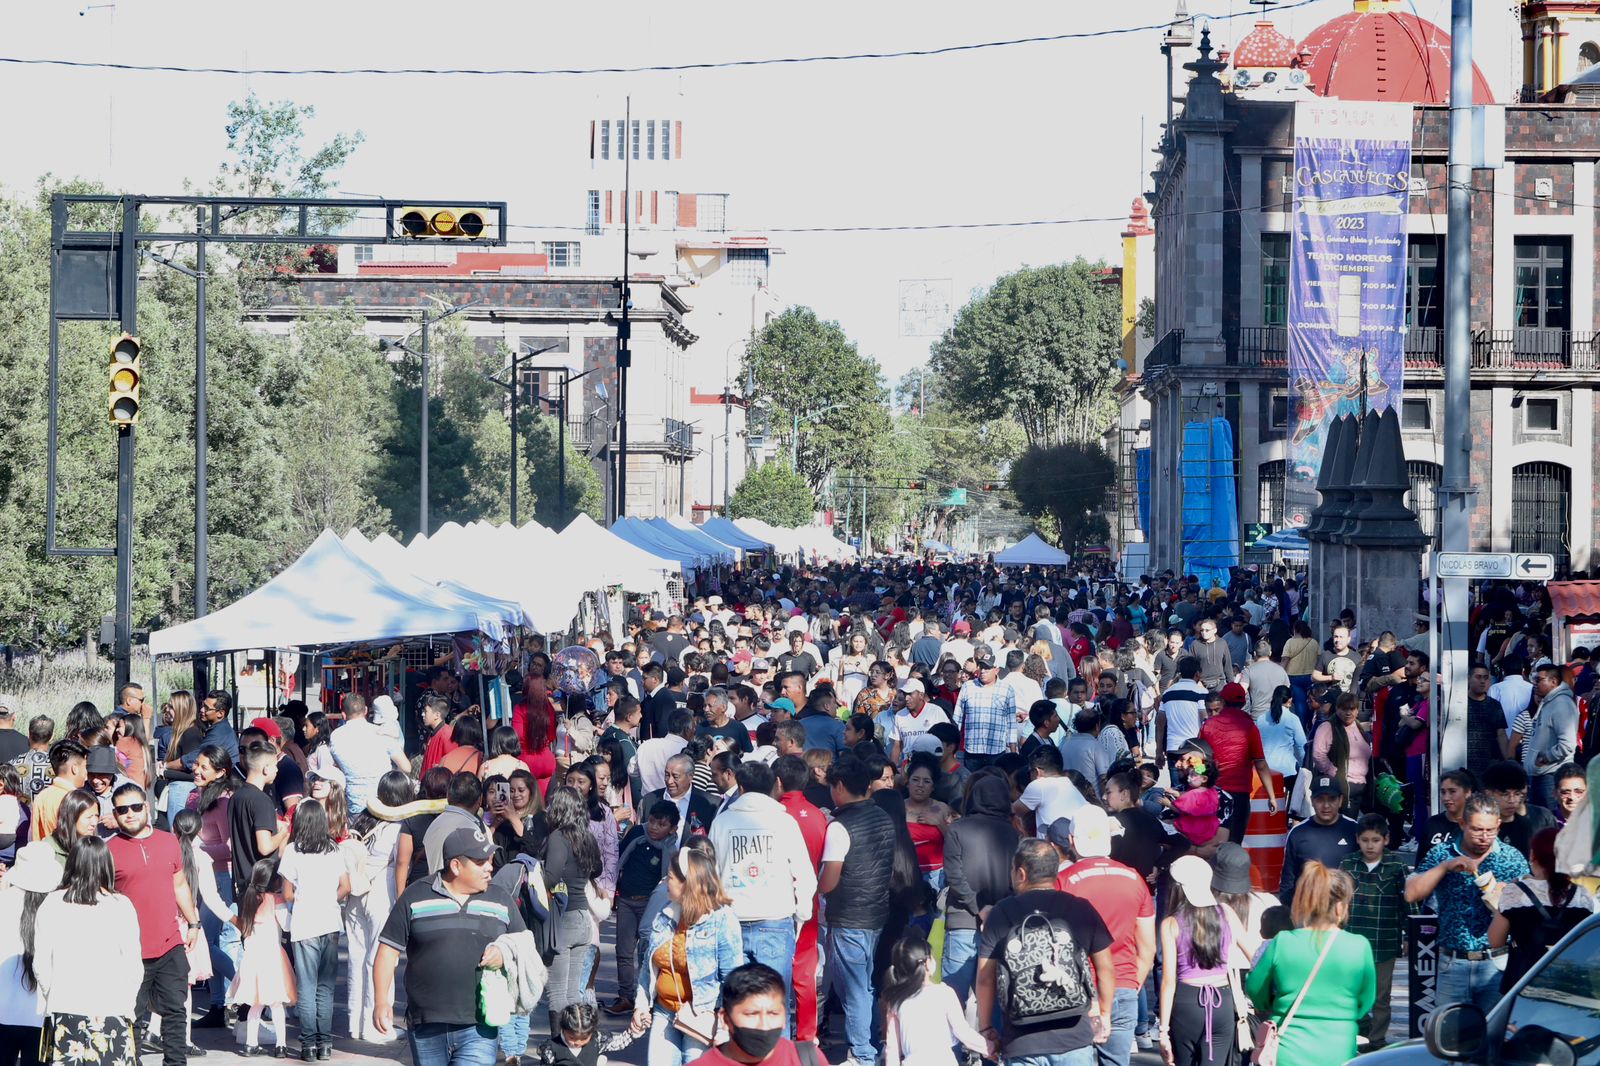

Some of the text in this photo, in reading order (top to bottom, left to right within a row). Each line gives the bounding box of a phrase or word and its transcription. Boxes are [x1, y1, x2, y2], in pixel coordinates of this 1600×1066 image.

[1336, 217, 1365, 229] 2023
[1307, 252, 1393, 263] TEATRO MORELOS
[1323, 264, 1376, 273] DICIEMBRE
[1440, 560, 1499, 570] NICOLAS BRAVO
[731, 835, 776, 864] BRAVE
